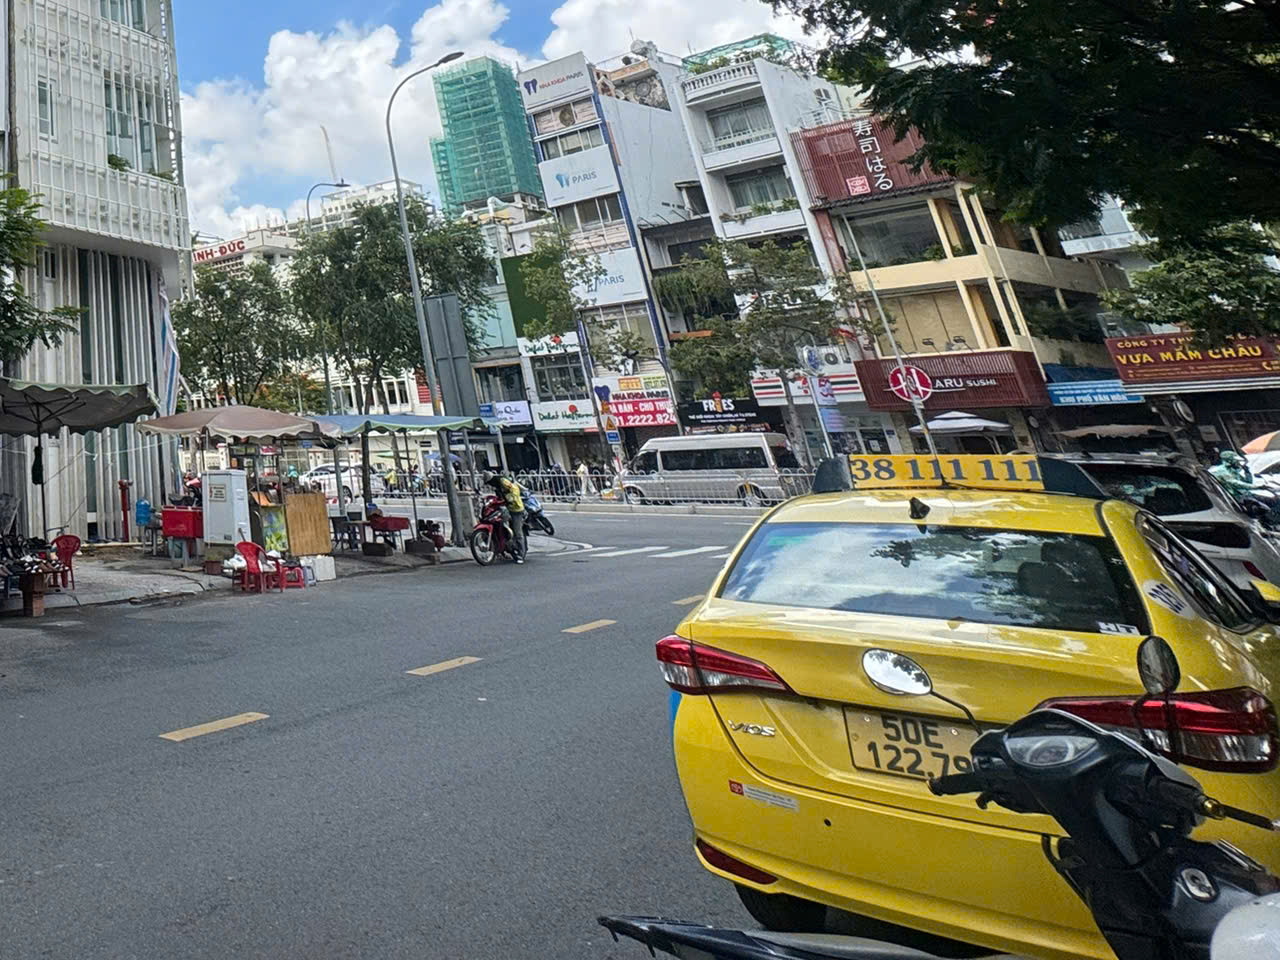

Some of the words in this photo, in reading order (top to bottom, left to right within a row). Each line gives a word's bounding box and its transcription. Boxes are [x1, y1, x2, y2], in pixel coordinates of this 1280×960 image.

[572, 170, 598, 184] PARIS
[599, 274, 625, 287] PARIS
[966, 378, 997, 387] SUSHI
[850, 458, 896, 481] 38
[905, 458, 968, 481] 111
[978, 459, 1042, 482] 111
[727, 719, 776, 738] VIOS
[881, 713, 944, 750] 50E
